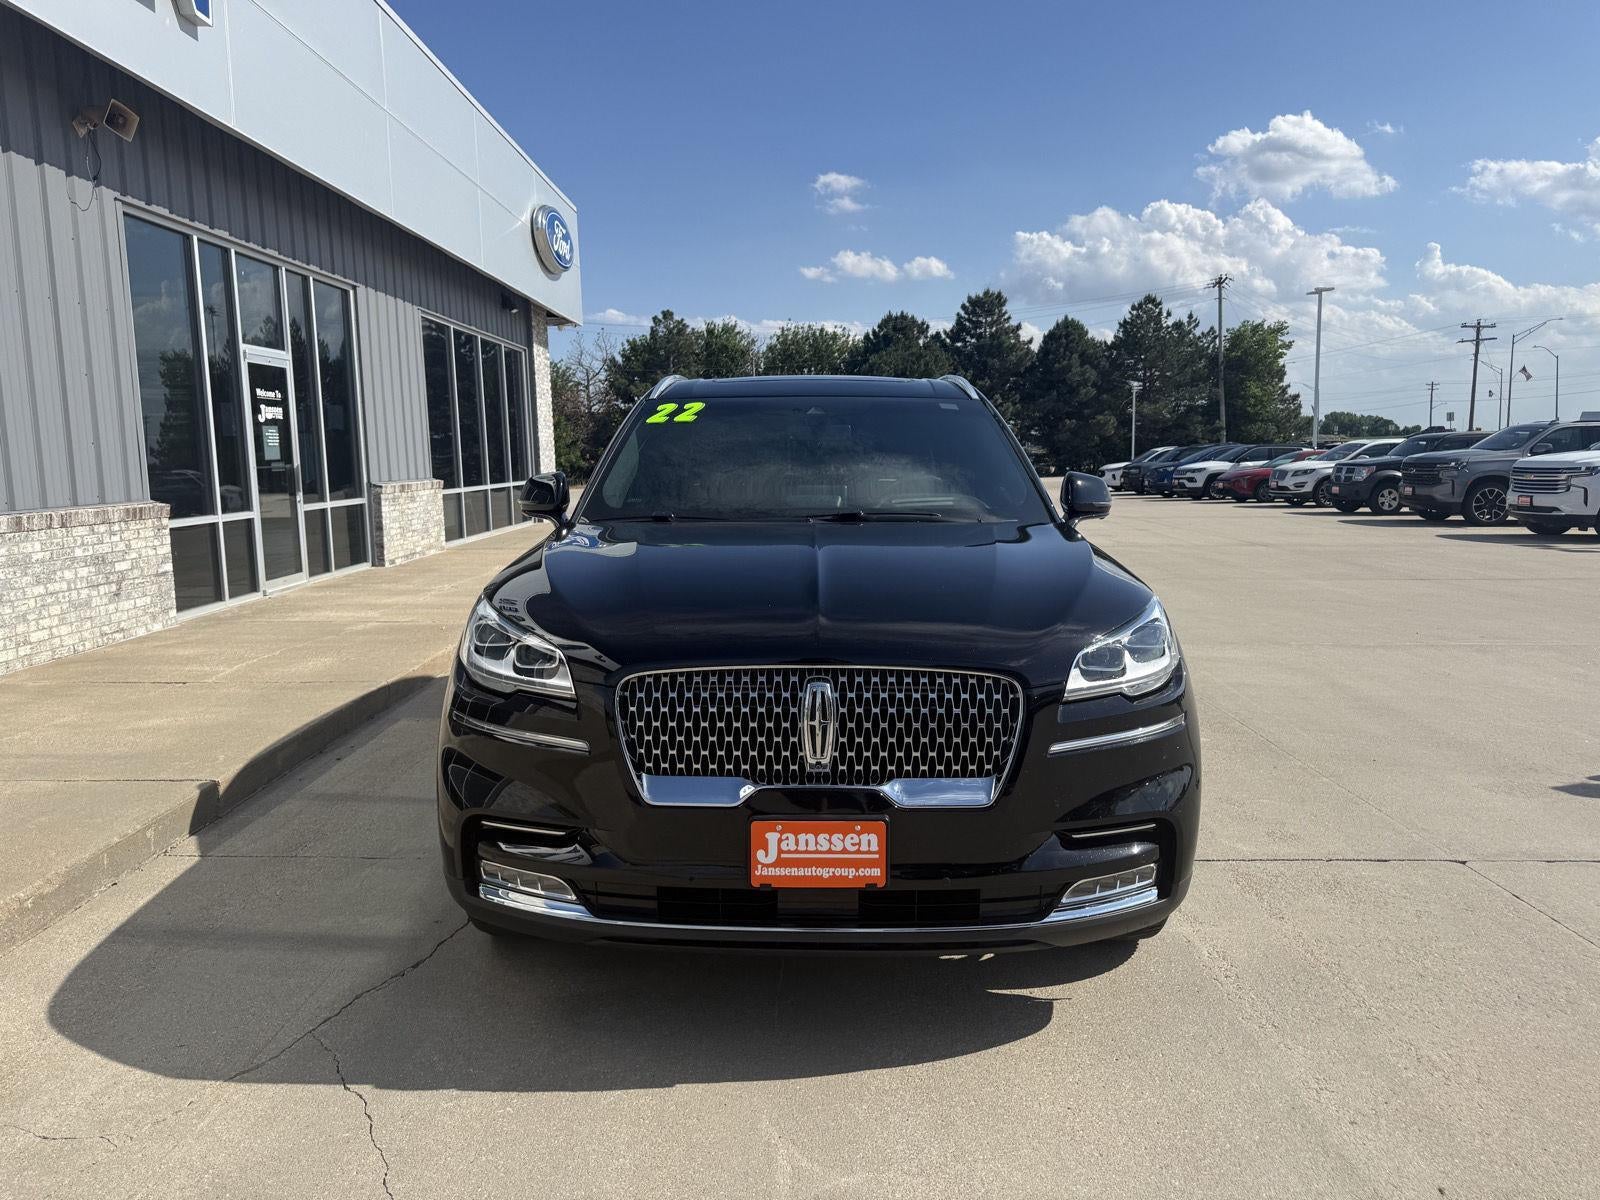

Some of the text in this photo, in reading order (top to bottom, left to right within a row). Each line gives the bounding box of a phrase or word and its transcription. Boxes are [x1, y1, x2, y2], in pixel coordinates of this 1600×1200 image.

[553, 220, 571, 261] Ford
[256, 388, 275, 398] Welcome
[645, 402, 706, 424] 22
[755, 864, 881, 878] Janssenautogroup.com
